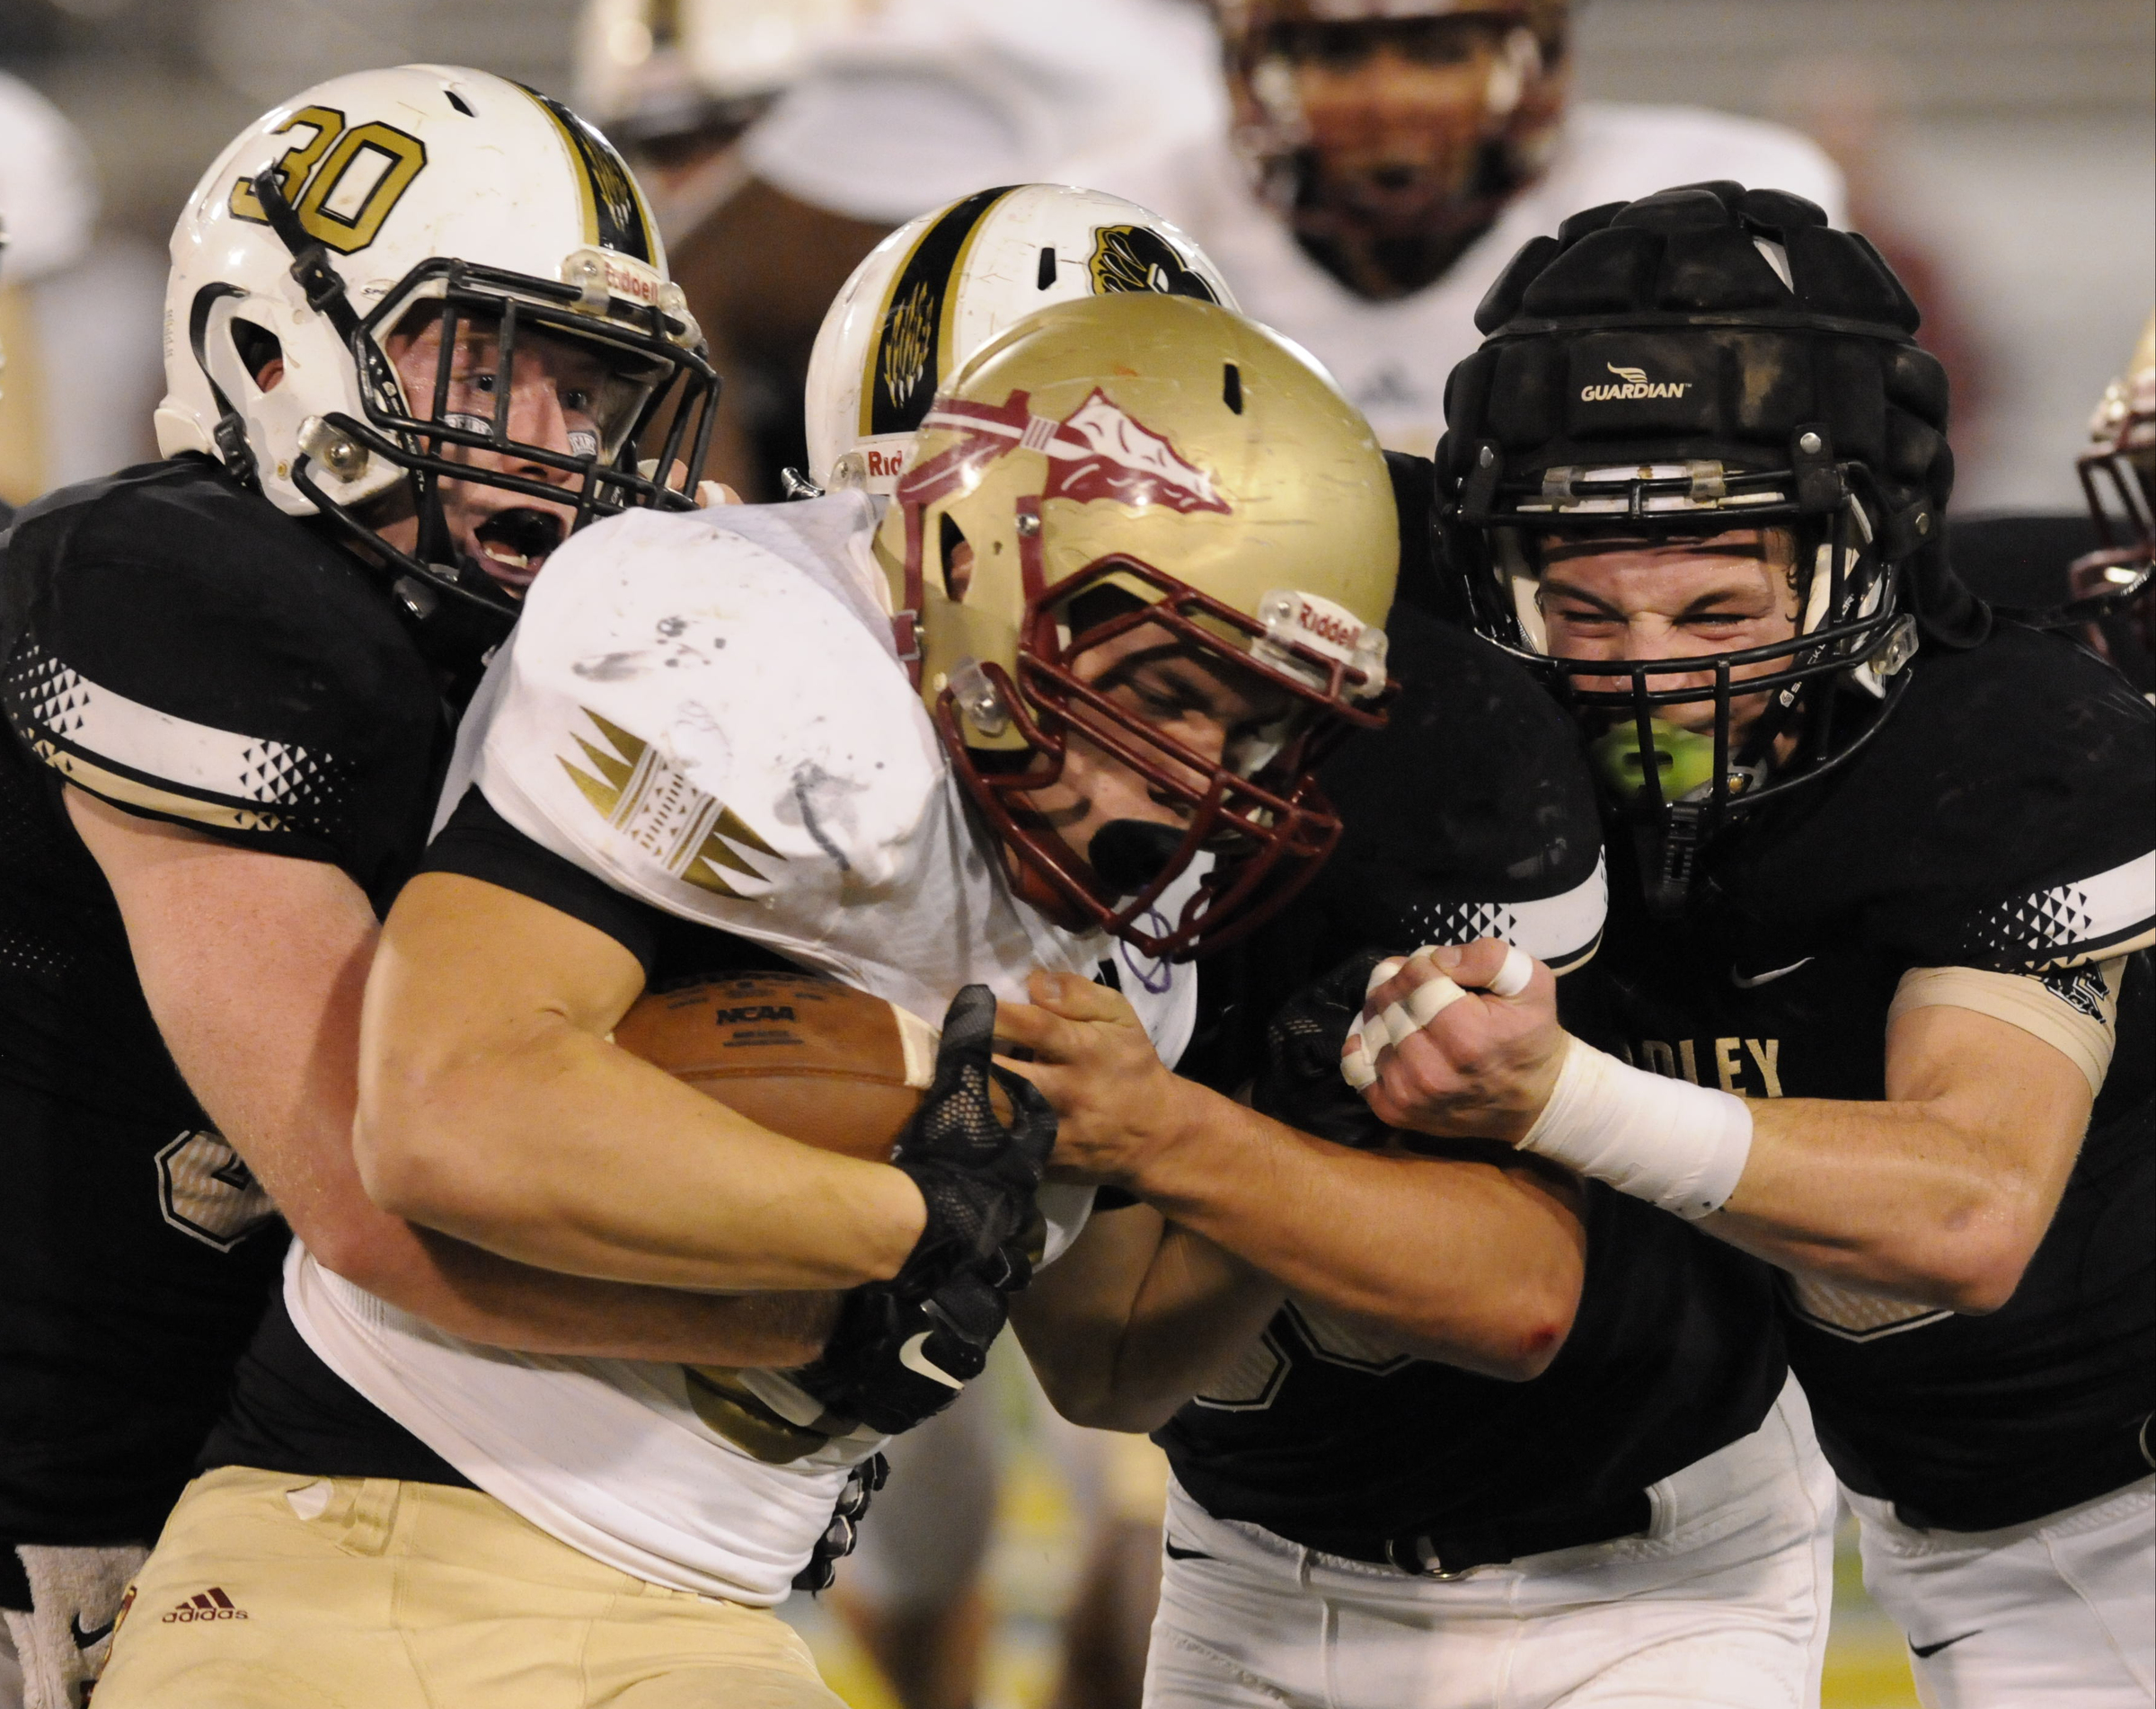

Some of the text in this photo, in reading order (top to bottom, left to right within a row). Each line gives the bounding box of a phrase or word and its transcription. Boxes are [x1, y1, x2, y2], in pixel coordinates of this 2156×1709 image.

[228, 104, 428, 256] 30
[868, 450, 903, 476] Rid
[717, 1005, 795, 1024] NCAA
[1621, 1037, 1783, 1098] DLEY
[163, 1607, 249, 1624] adidas
